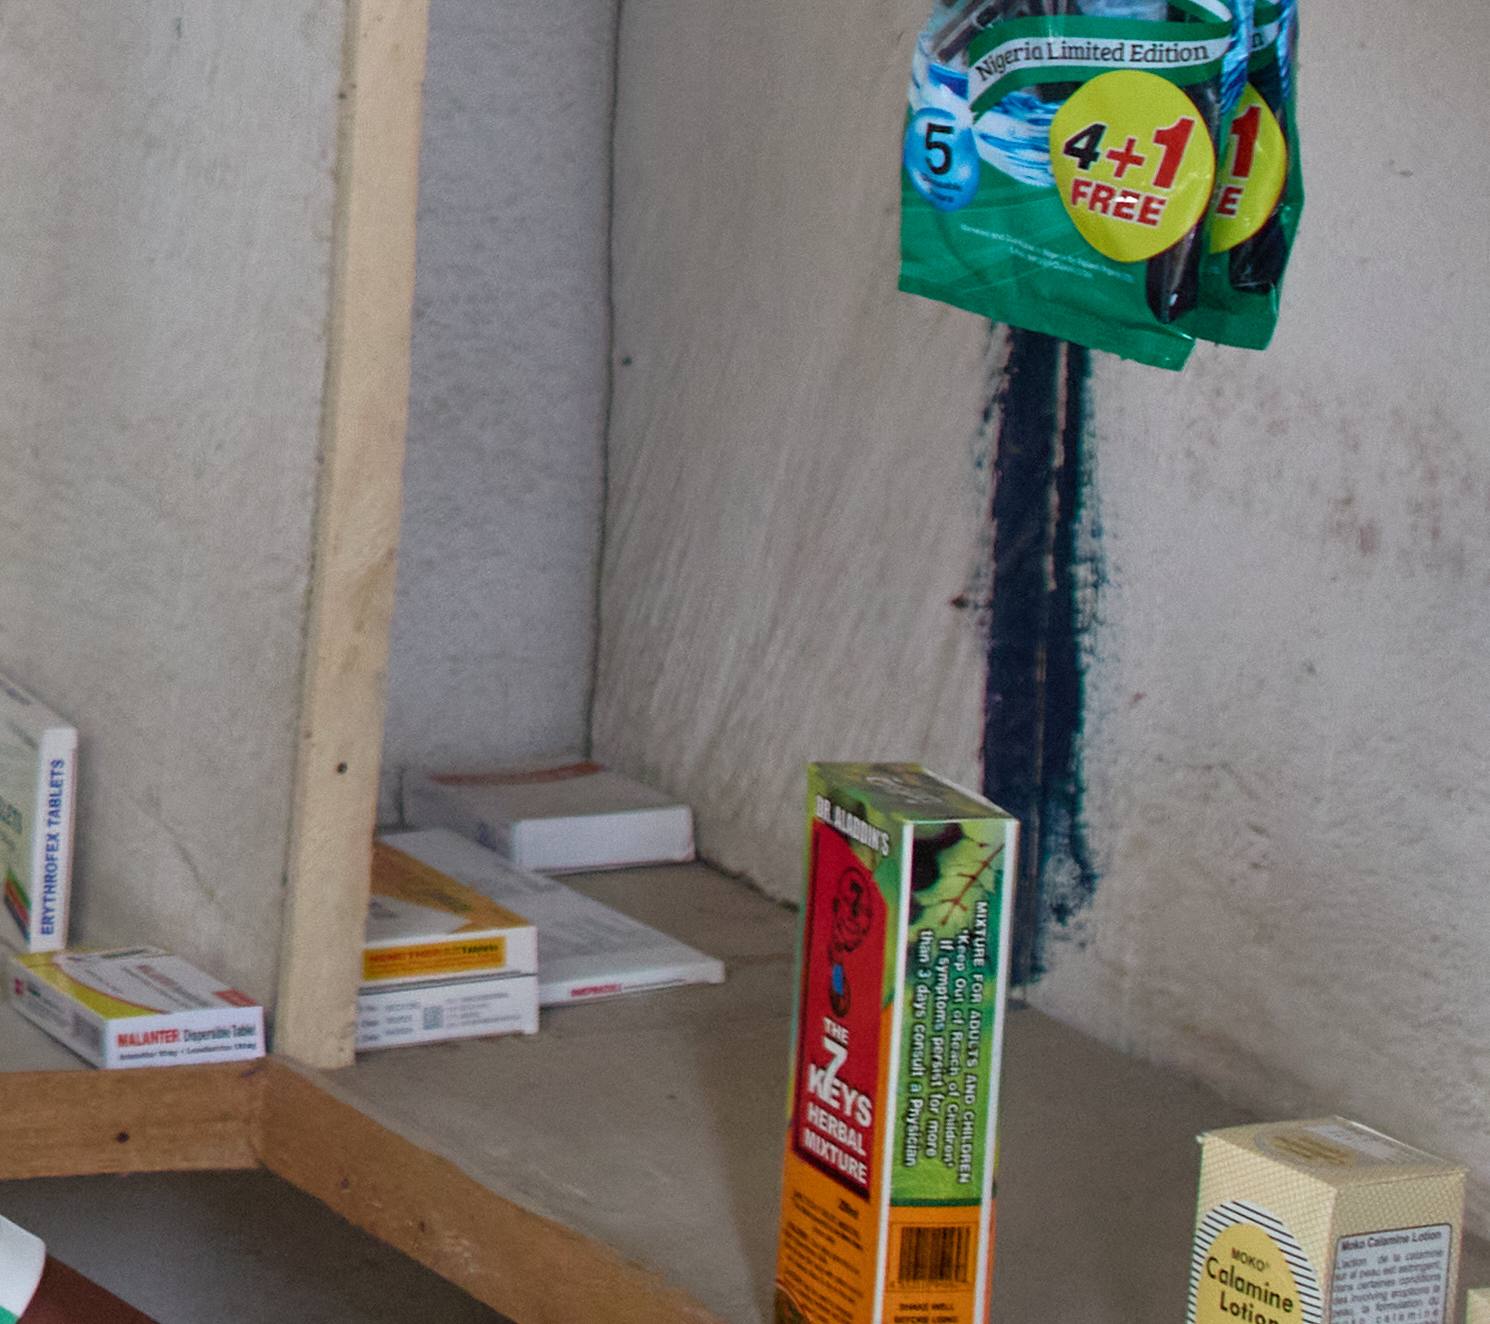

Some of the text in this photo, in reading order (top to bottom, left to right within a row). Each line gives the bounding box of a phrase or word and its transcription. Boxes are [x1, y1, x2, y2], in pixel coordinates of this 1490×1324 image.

[976, 41, 1209, 82] Nigeria Limited Edition
[925, 122, 952, 174] 5
[1071, 179, 1166, 228] FREE
[40, 758, 64, 937] ERYTHROFEX TABLETS
[823, 1016, 849, 1046] THE
[957, 902, 988, 1184] MIXTURE FOR ADULTS AND CHILDREN
[808, 1063, 872, 1127] KEYS
[803, 1127, 867, 1185] MIXTURE
[807, 1102, 866, 1156] HERBAL
[1206, 1255, 1294, 1313] Calamine
[1231, 1246, 1266, 1272] MOKO
